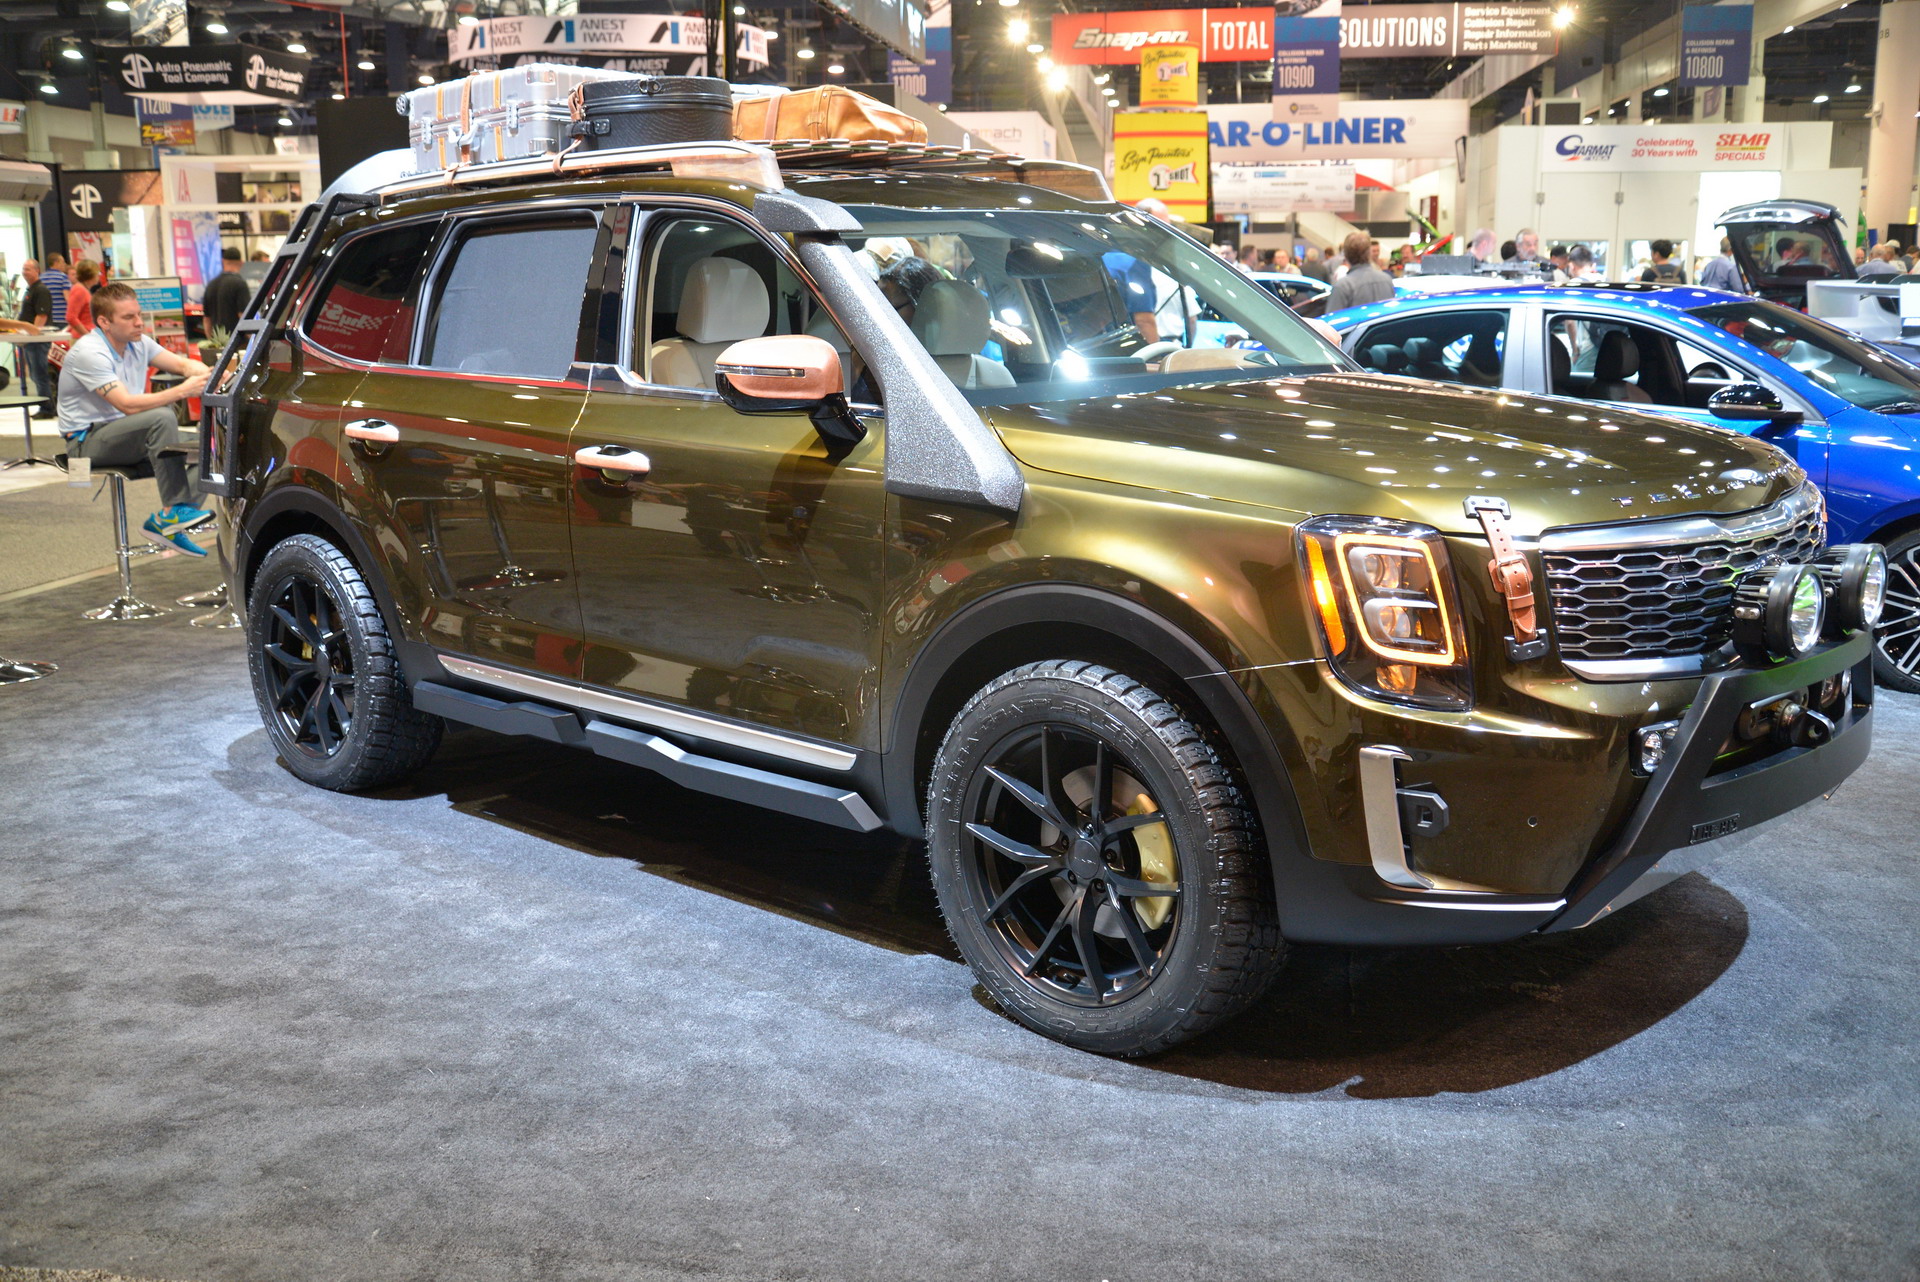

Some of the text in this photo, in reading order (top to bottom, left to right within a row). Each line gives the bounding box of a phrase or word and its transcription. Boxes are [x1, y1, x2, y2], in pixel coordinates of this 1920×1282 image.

[1501, 6, 1551, 17] Equipment
[580, 19, 627, 30] ANEST
[1506, 17, 1536, 29] Repair
[583, 32, 625, 43] IWATA
[1210, 21, 1269, 51] TOTAL
[1338, 16, 1447, 48] SOLUTIONS
[1495, 28, 1551, 39] Information
[1072, 28, 1190, 51] Snap-on
[1489, 40, 1538, 52] Marketing
[155, 60, 233, 73] Astro Pneumatic
[628, 58, 670, 70] ANEST
[1686, 56, 1724, 79] 10800
[162, 72, 230, 84] Tool Company
[1278, 65, 1315, 89] 10900
[1209, 118, 1406, 147] AR-O-LINER
[1636, 137, 1694, 149] Celebrating
[1716, 133, 1772, 147] SEMA
[1631, 148, 1698, 158] 30 Years with
[1714, 152, 1766, 161] SPECIALS
[1611, 460, 1798, 508] TELLU
